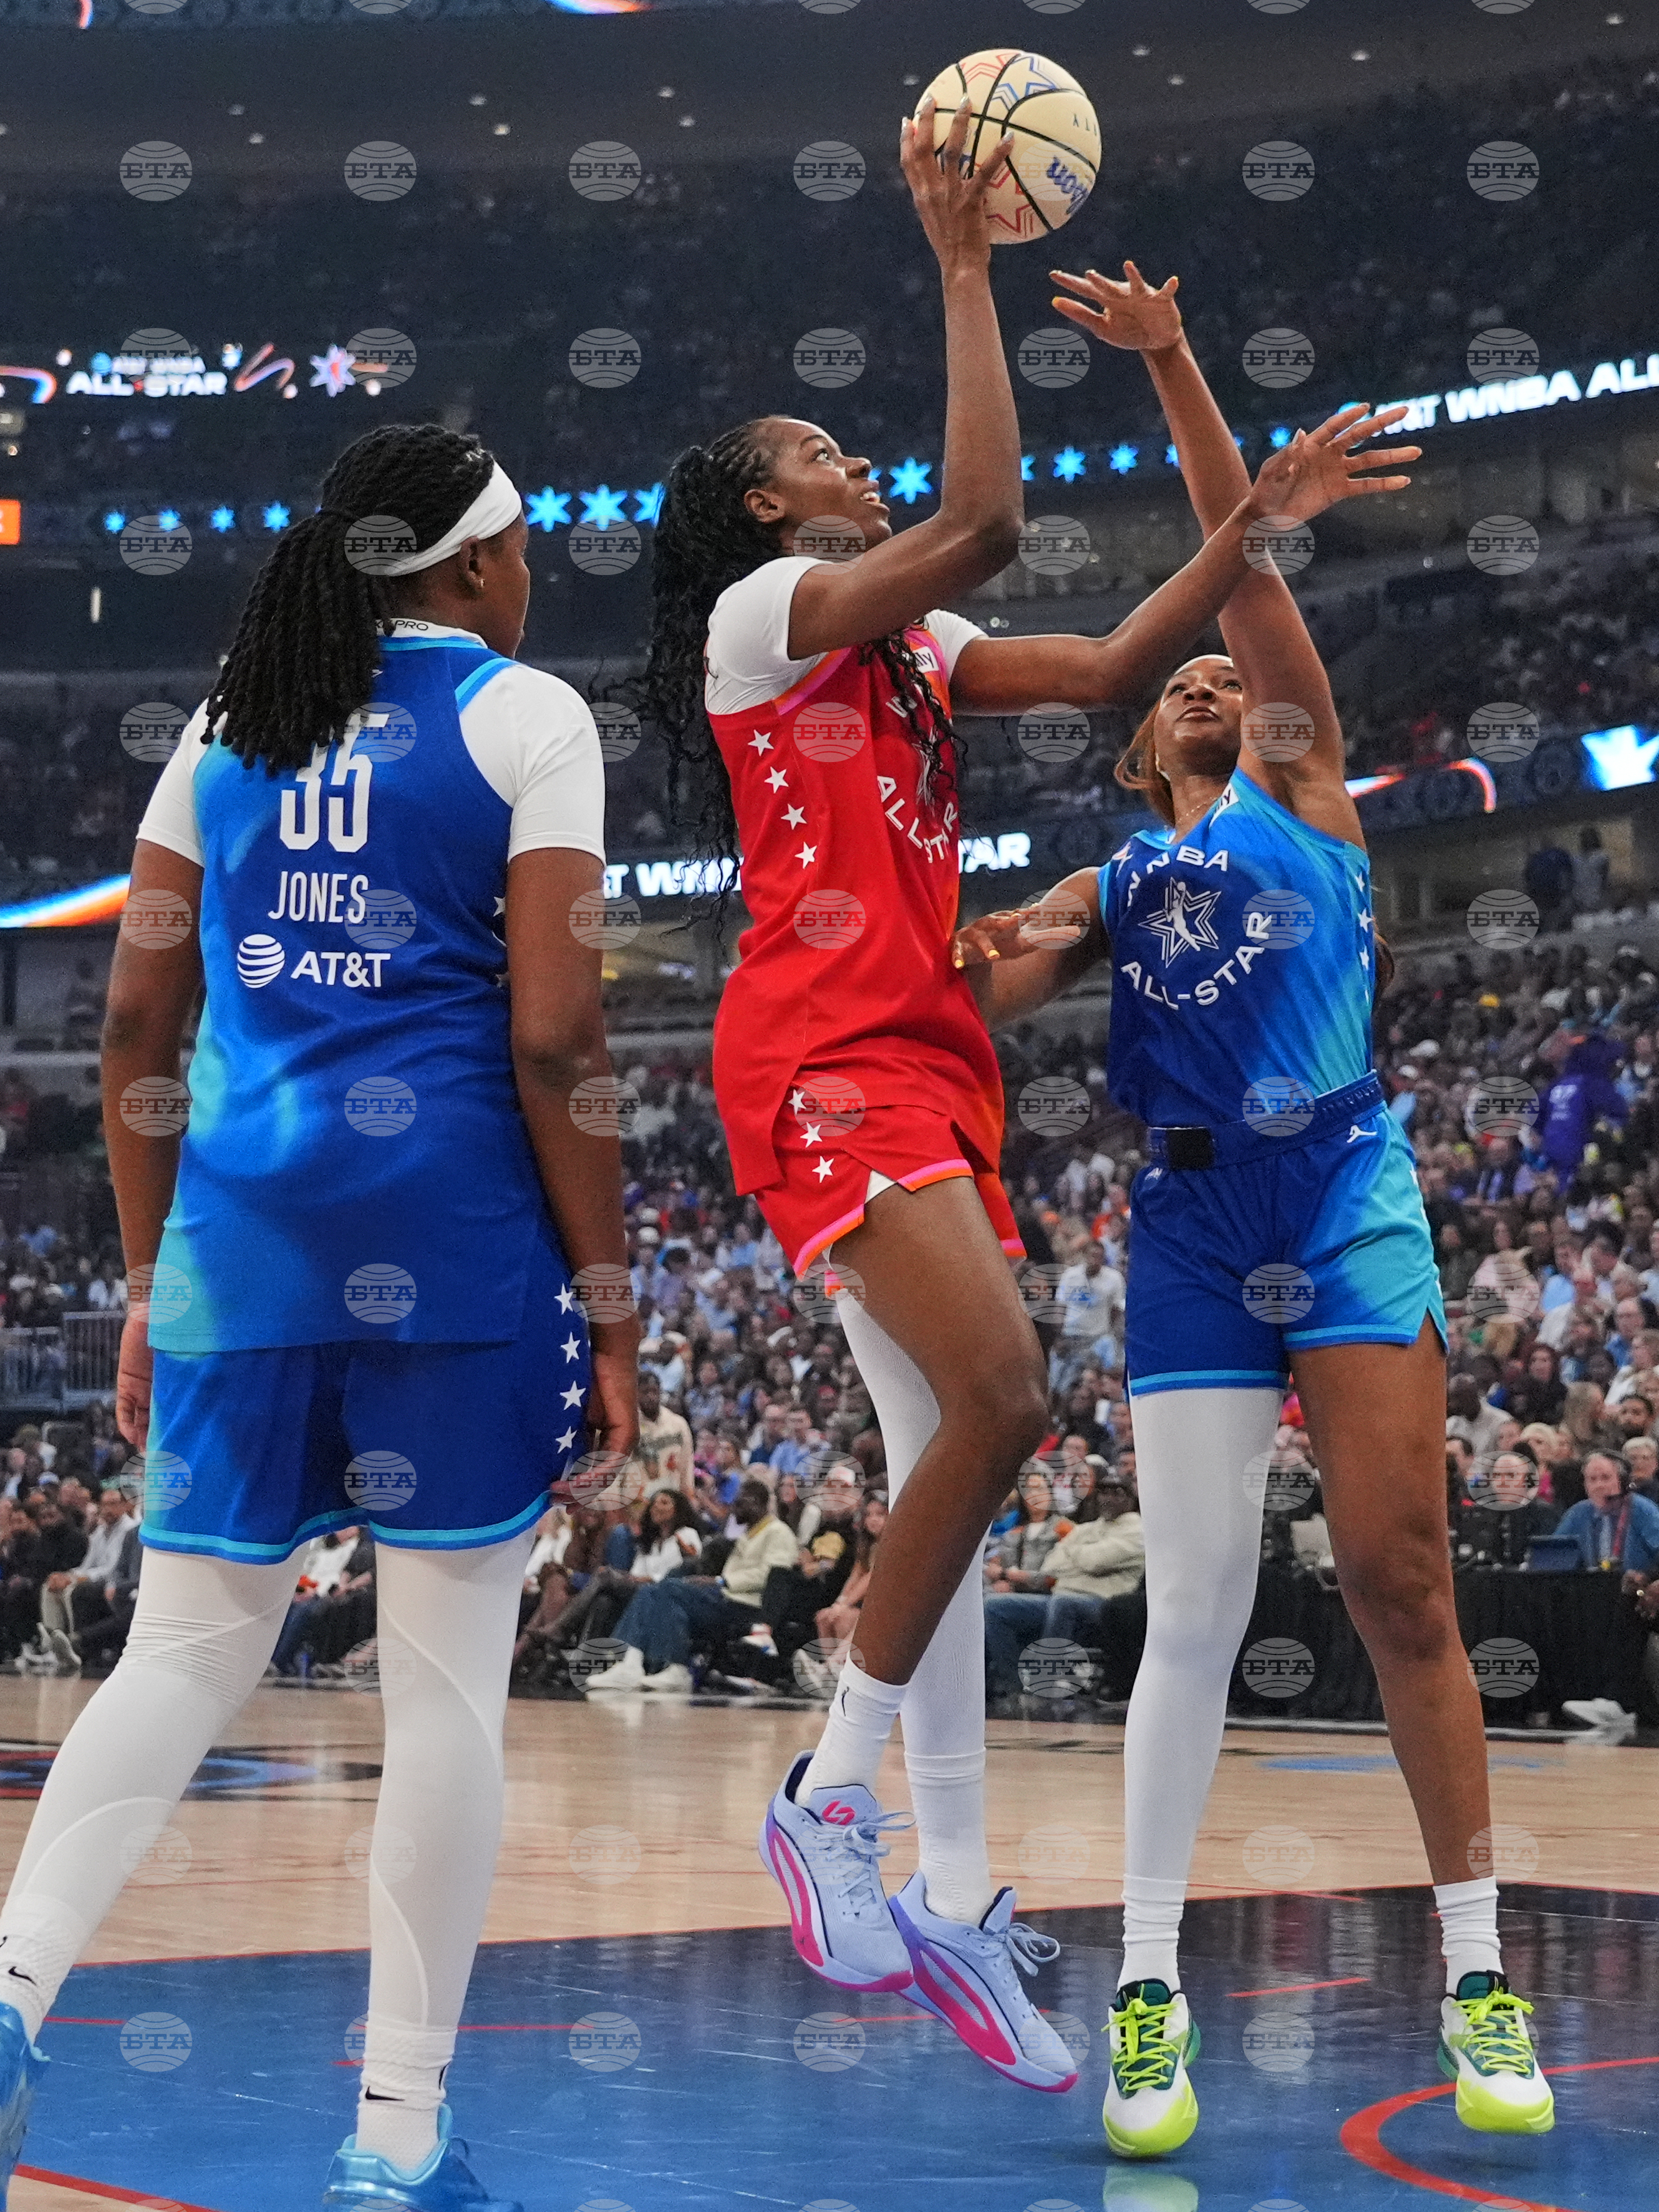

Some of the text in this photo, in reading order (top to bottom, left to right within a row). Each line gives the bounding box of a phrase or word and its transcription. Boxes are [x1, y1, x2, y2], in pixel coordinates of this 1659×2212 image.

[1445, 370, 1582, 423] WNBA
[395, 620, 428, 631] PRO
[280, 713, 390, 853] 35
[268, 871, 369, 924] JONES
[291, 950, 391, 988] AT&T
[1120, 911, 1272, 1010] ALL-STAR
